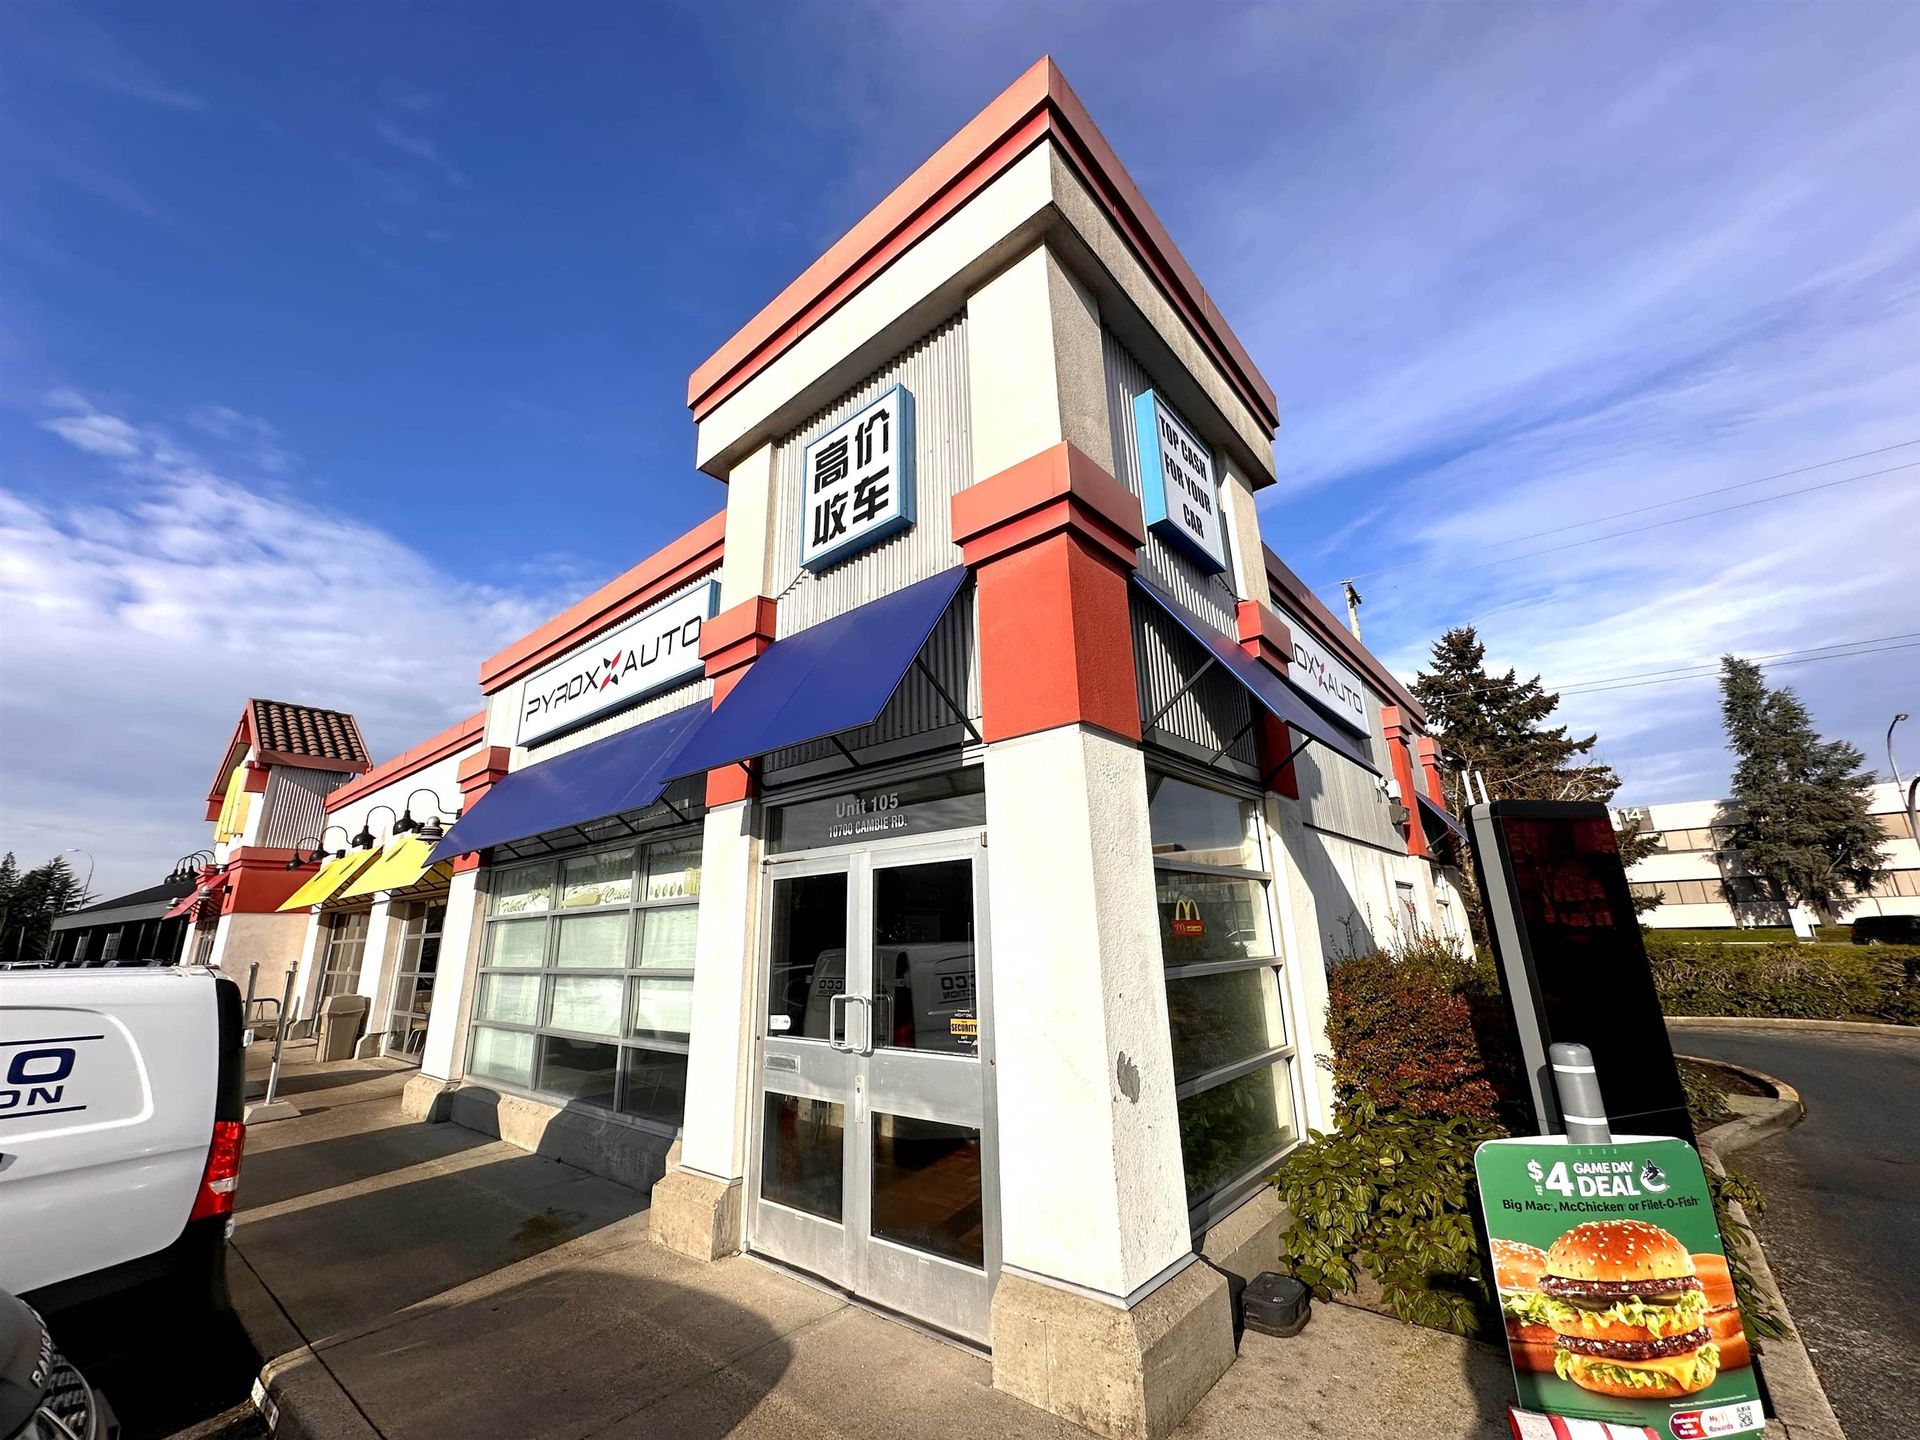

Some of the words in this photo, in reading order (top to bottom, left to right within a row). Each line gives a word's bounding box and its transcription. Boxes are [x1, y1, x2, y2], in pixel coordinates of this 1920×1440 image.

[814, 408, 890, 494] 高价
[1159, 413, 1179, 451] TOP
[1181, 438, 1208, 481] CASH
[1163, 451, 1185, 490] FOR
[1184, 472, 1212, 516] YOUR
[812, 465, 890, 548] 收车
[1182, 503, 1205, 540] CAR
[621, 615, 702, 677] AUTO
[836, 799, 867, 818] Unit
[871, 792, 899, 812] 105
[828, 822, 853, 838] 10700
[855, 816, 889, 834] CAMBIE
[891, 814, 908, 829] RD.
[951, 1023, 977, 1033] SECURITY
[1572, 1162, 1611, 1175] GAME
[1611, 1161, 1633, 1173] DAY
[1576, 1175, 1641, 1197] DEAL
[1503, 1199, 1522, 1212] Big
[1559, 1201, 1624, 1212] McChicken
[1628, 1203, 1639, 1211] or
